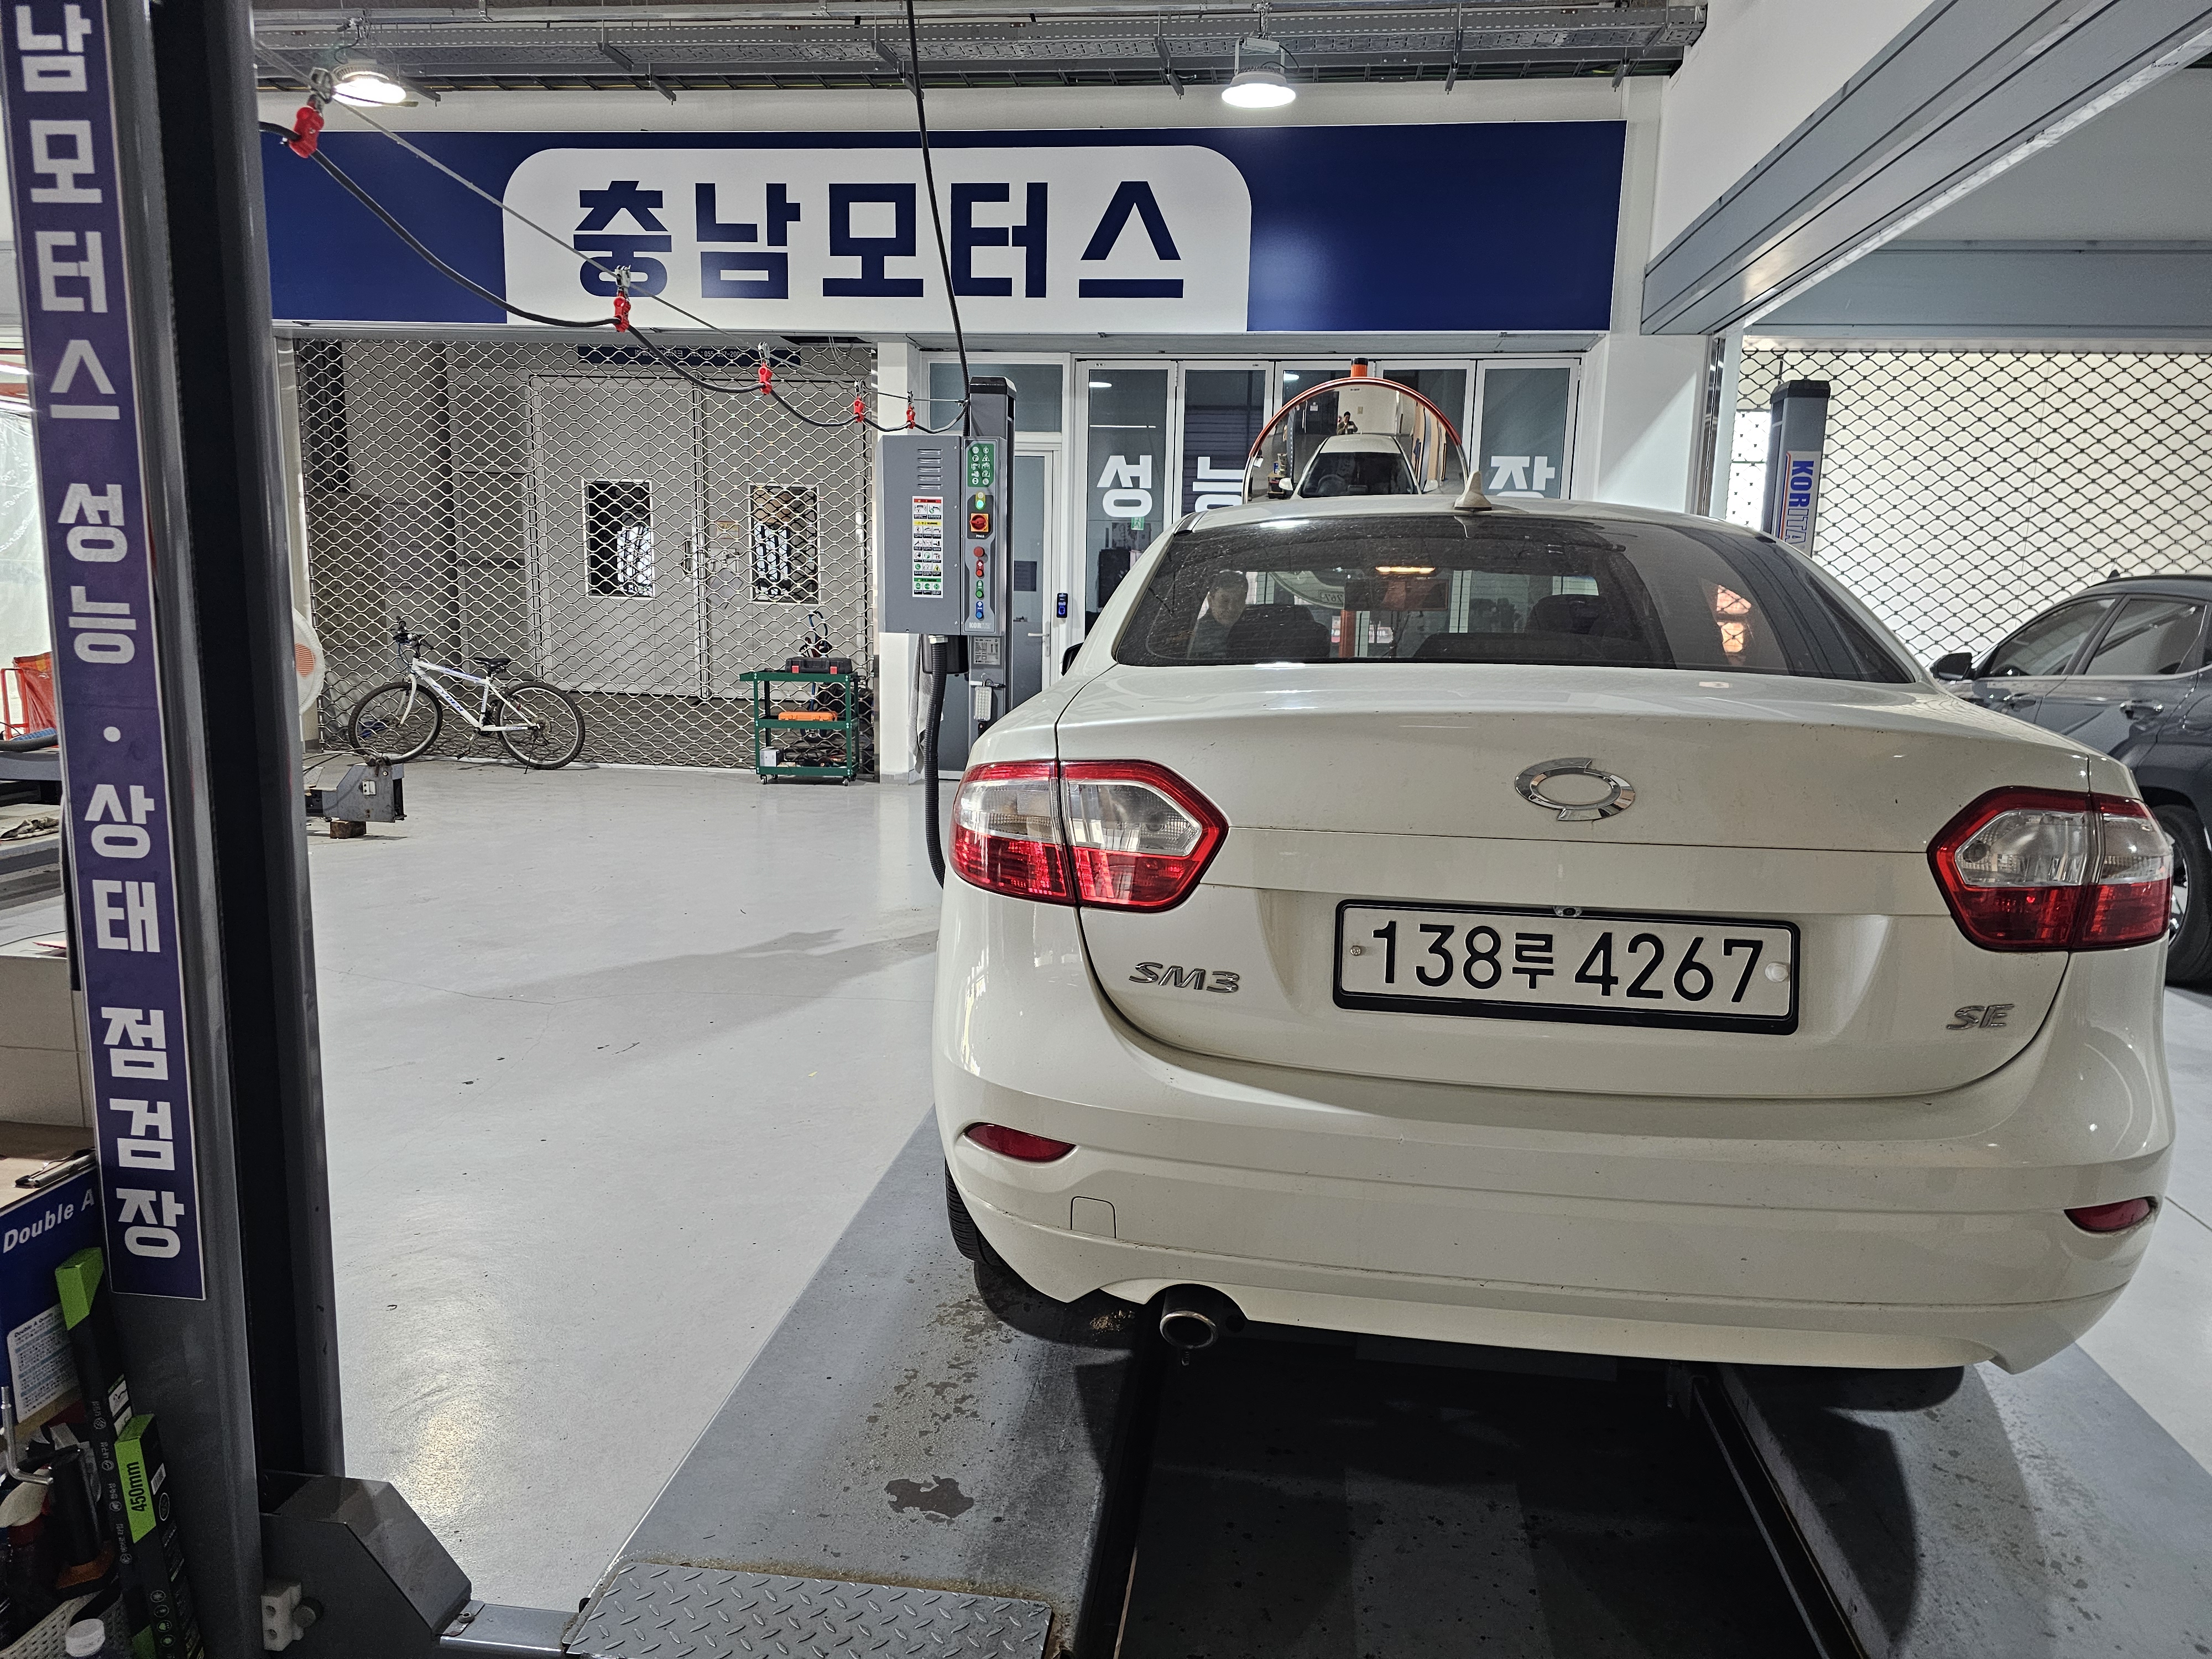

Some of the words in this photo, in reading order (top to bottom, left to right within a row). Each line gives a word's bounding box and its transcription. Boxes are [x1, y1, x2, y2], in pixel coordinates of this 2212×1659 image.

[573, 180, 1184, 300] 충남모터스
[1785, 461, 1814, 544] KORITA
[58, 483, 137, 664] 성능
[85, 784, 160, 953] 상태
[1128, 961, 1240, 993] SM3
[1945, 1004, 2015, 1030] SE
[101, 1006, 185, 1259] 점검장
[3, 1203, 74, 1254] Double
[81, 1188, 95, 1212] A
[126, 1461, 147, 1512] 450mm
